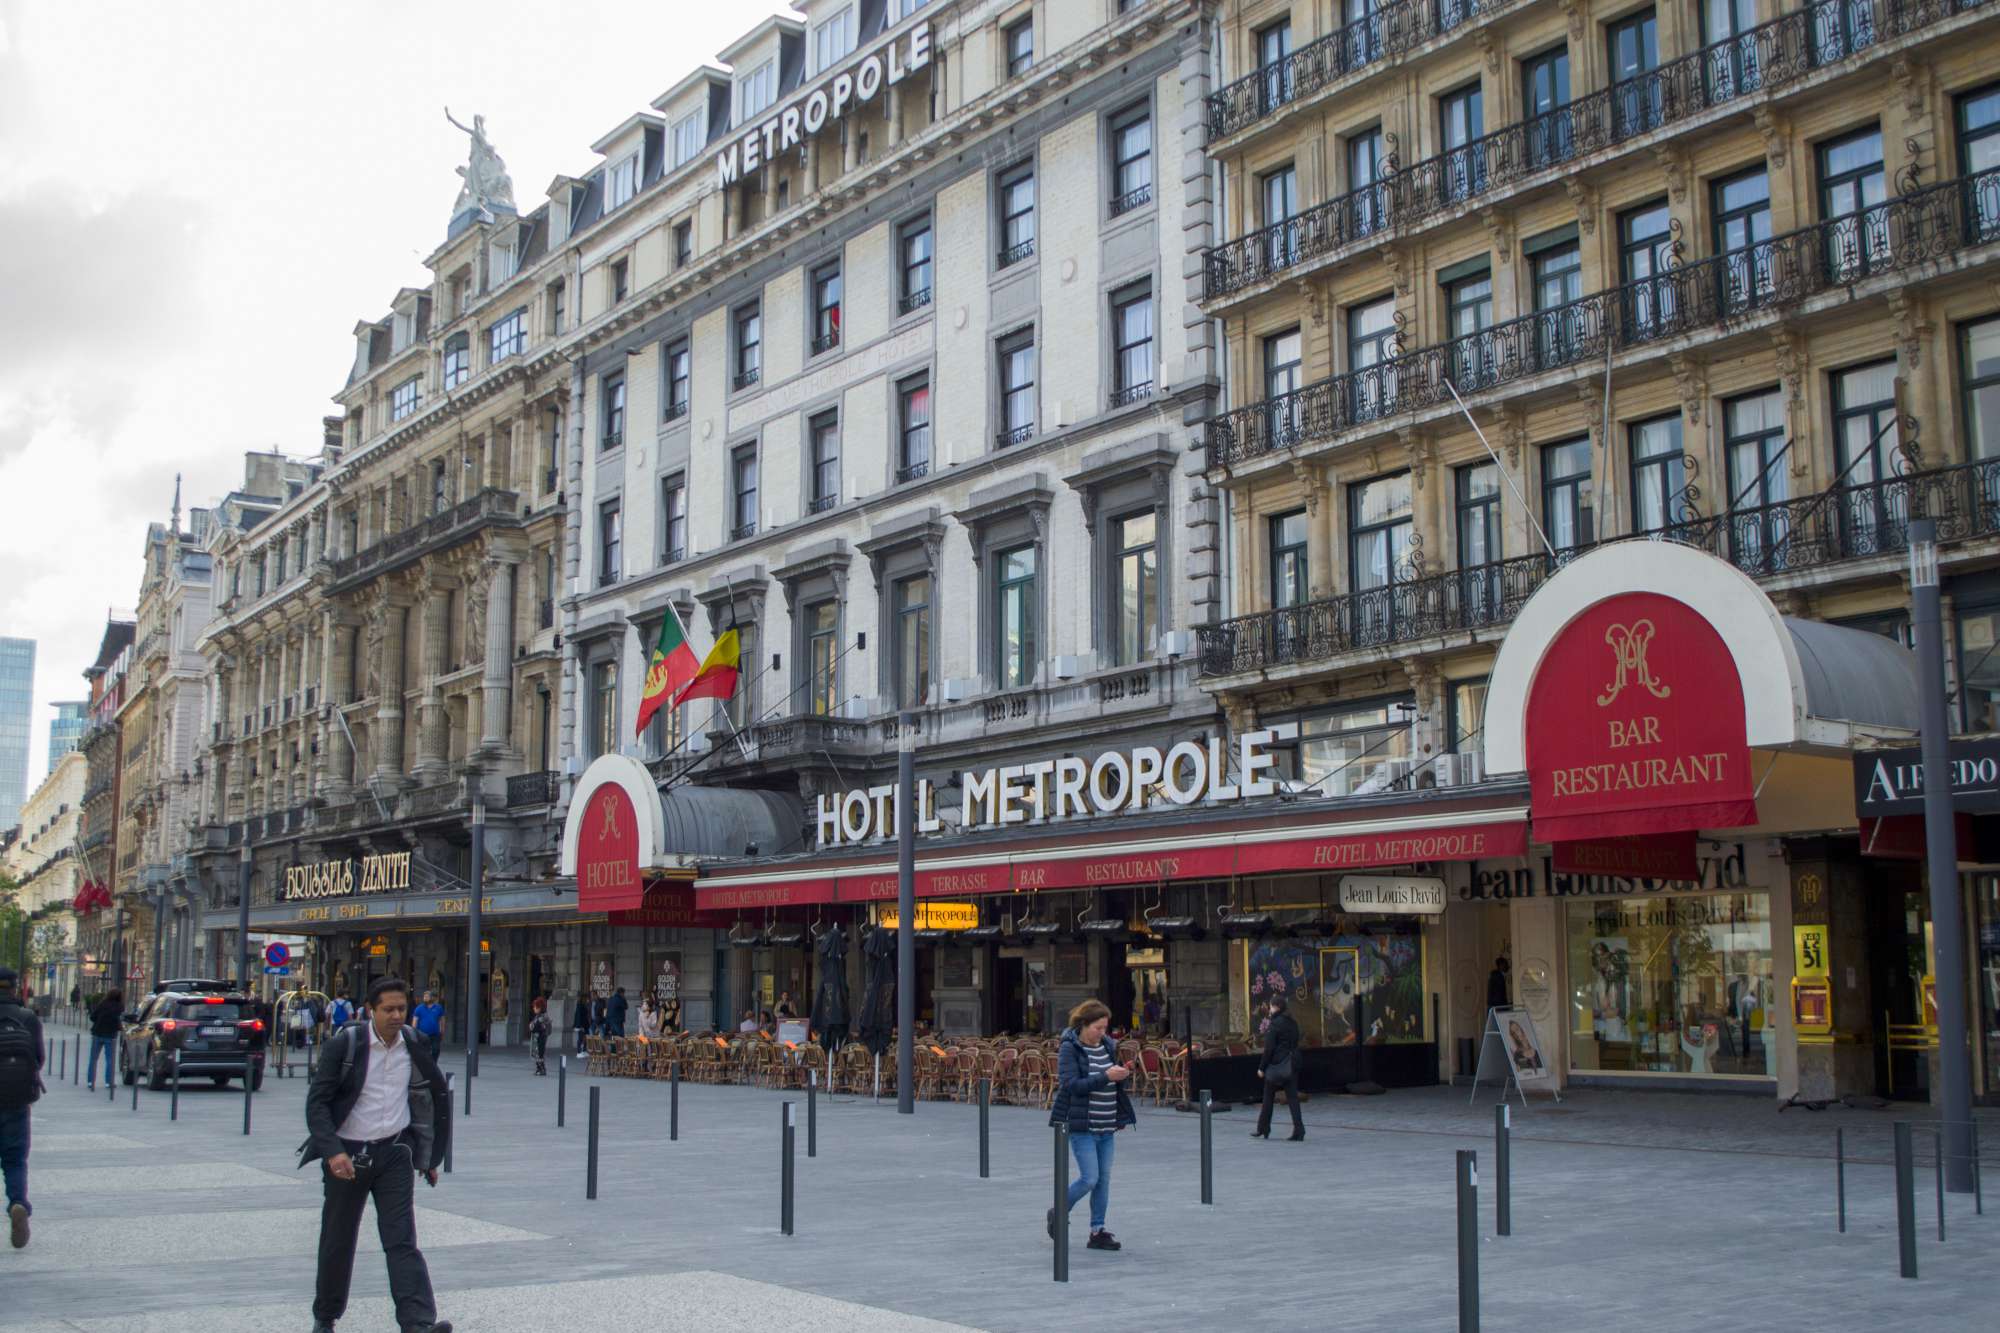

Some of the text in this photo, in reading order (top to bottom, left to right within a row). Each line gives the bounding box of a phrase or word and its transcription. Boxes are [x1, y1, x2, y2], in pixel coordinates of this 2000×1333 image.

[718, 20, 932, 190] METROPOLE
[1607, 716, 1663, 748] BAR
[817, 729, 1278, 845] HOTL METROPOLE
[1552, 753, 1728, 797] RESTAURANT
[1863, 757, 1997, 803] ALFEDO
[1313, 834, 1485, 864] HOTEL METROPOLE
[284, 851, 411, 899] BRUSSELS ZENITH
[587, 860, 634, 888] HOTEL
[932, 873, 988, 892] TERRASSE
[1020, 857, 1180, 886] BAR RESTAURANTS
[1460, 860, 1536, 900] Jean
[712, 887, 790, 905] HOTEL METROPOLE
[1345, 884, 1441, 905] Jean Louis David
[1636, 904, 1687, 927] Louis
